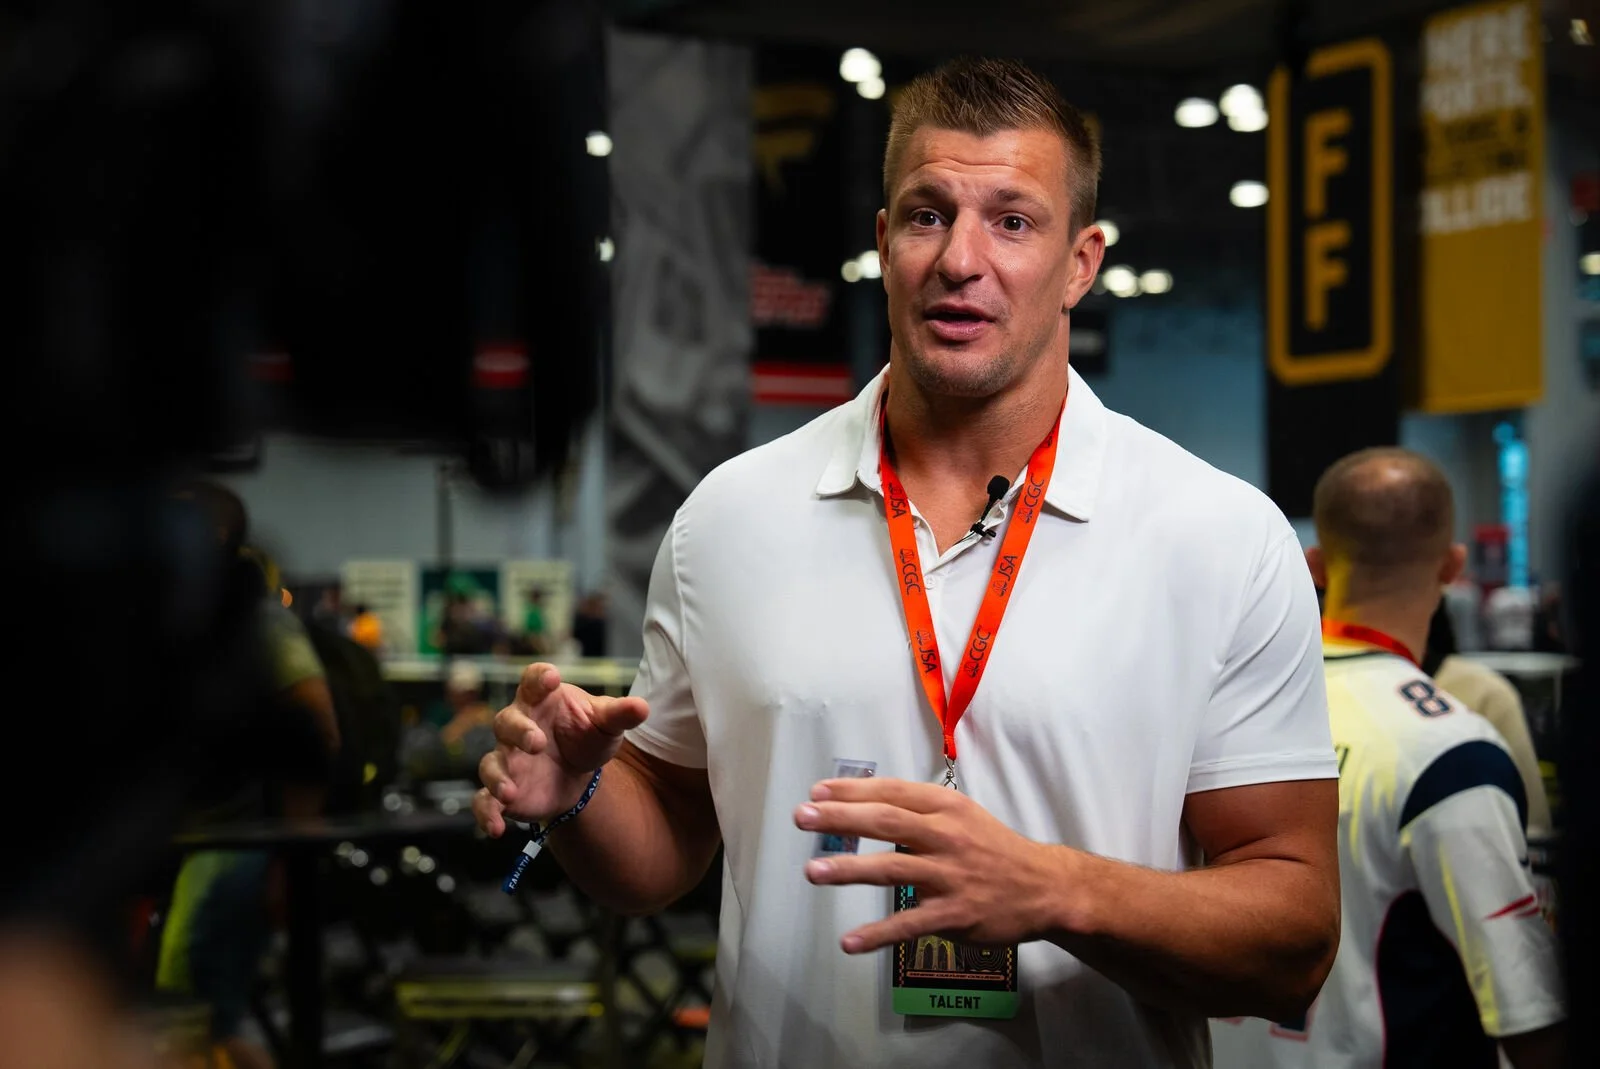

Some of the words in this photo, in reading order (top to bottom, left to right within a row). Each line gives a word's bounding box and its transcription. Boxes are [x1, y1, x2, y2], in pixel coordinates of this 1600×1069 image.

[1023, 472, 1045, 508] CGC
[902, 563, 921, 595] CGC
[999, 554, 1018, 581] JSA
[919, 647, 938, 674] JSA
[970, 627, 991, 662] CGC
[1397, 678, 1453, 721] 8
[929, 994, 981, 1009] TALENT
